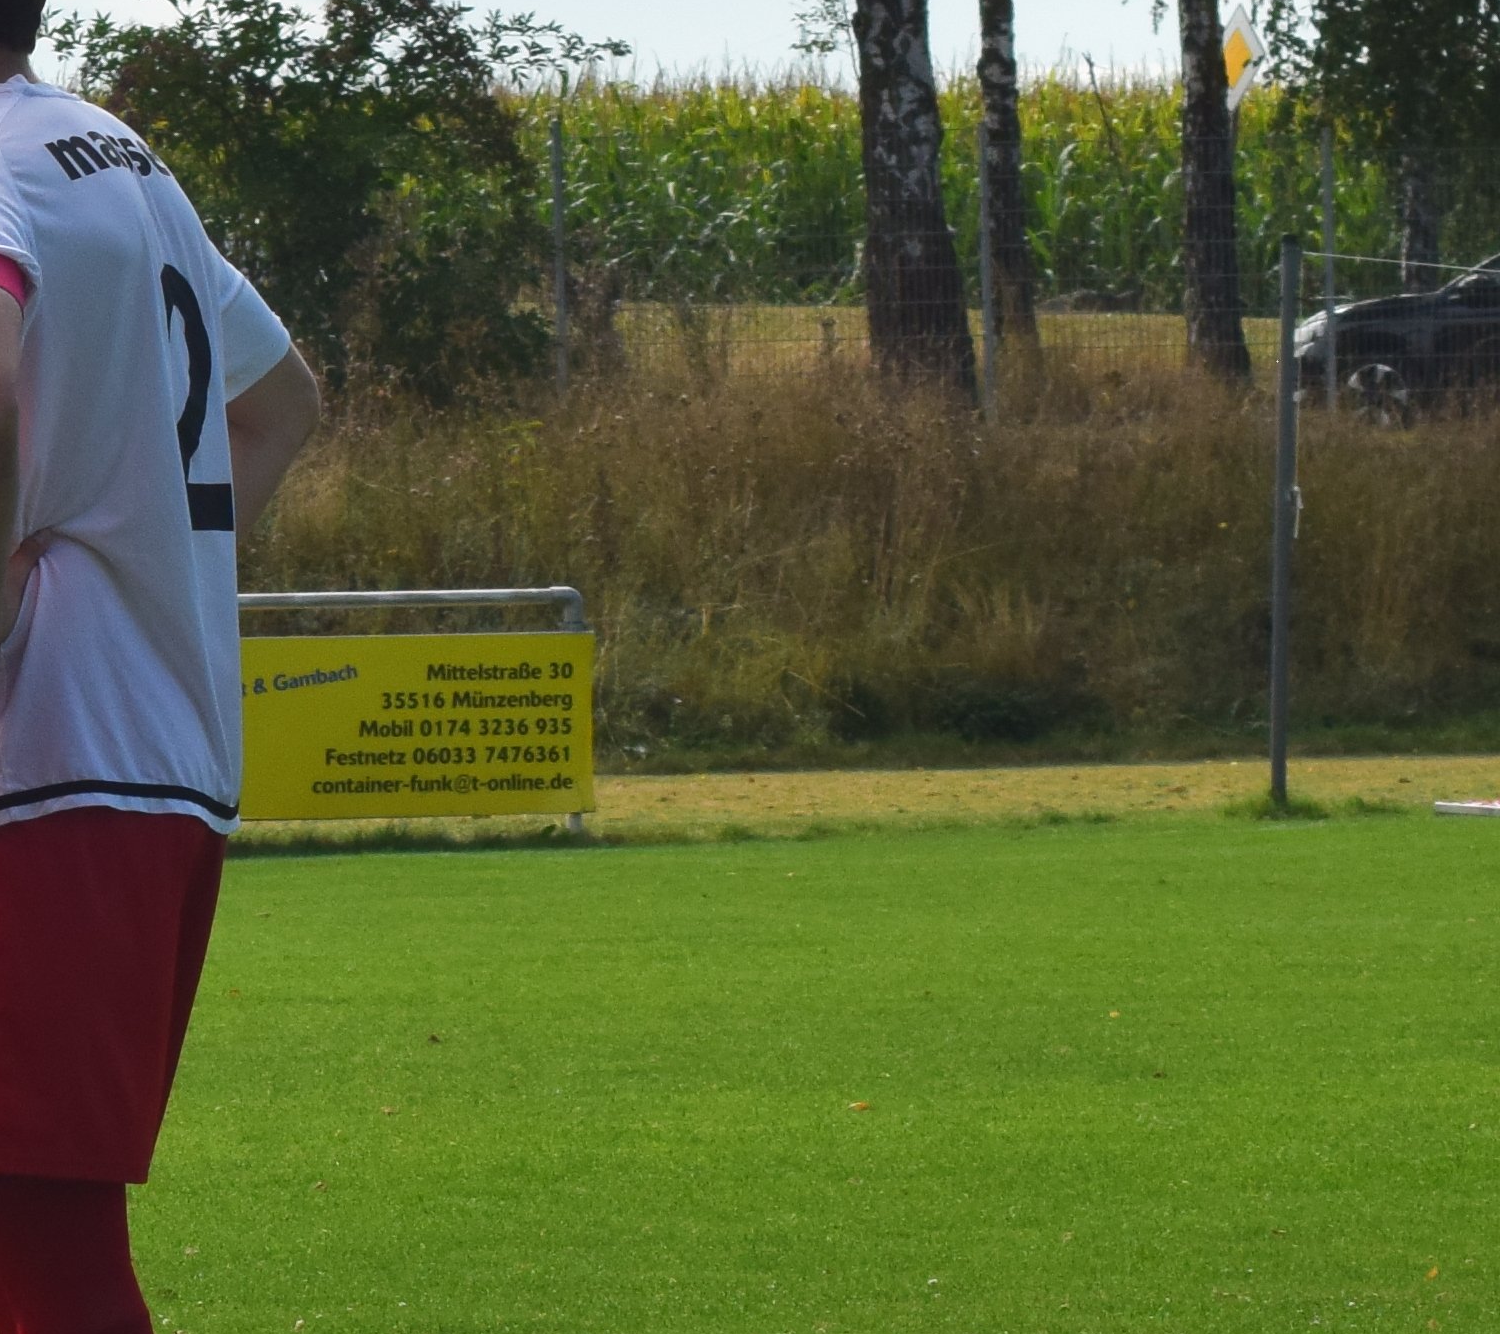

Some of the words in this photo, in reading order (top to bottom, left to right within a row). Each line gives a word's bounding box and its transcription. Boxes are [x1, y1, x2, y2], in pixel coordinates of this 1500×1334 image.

[273, 664, 359, 691] Gambach
[427, 662, 542, 681] Mittelstraße
[549, 662, 573, 679] 30
[382, 691, 445, 709] 35516
[452, 690, 573, 711] Münzenberg
[359, 719, 414, 737] Mobil
[420, 719, 471, 737] 0174
[478, 718, 529, 736] 3236
[536, 717, 572, 735] 935
[325, 748, 406, 766] Festnetz
[413, 747, 476, 765] 06033
[485, 746, 571, 764] 7476361
[312, 773, 573, 794] container-funk@t-online.de
